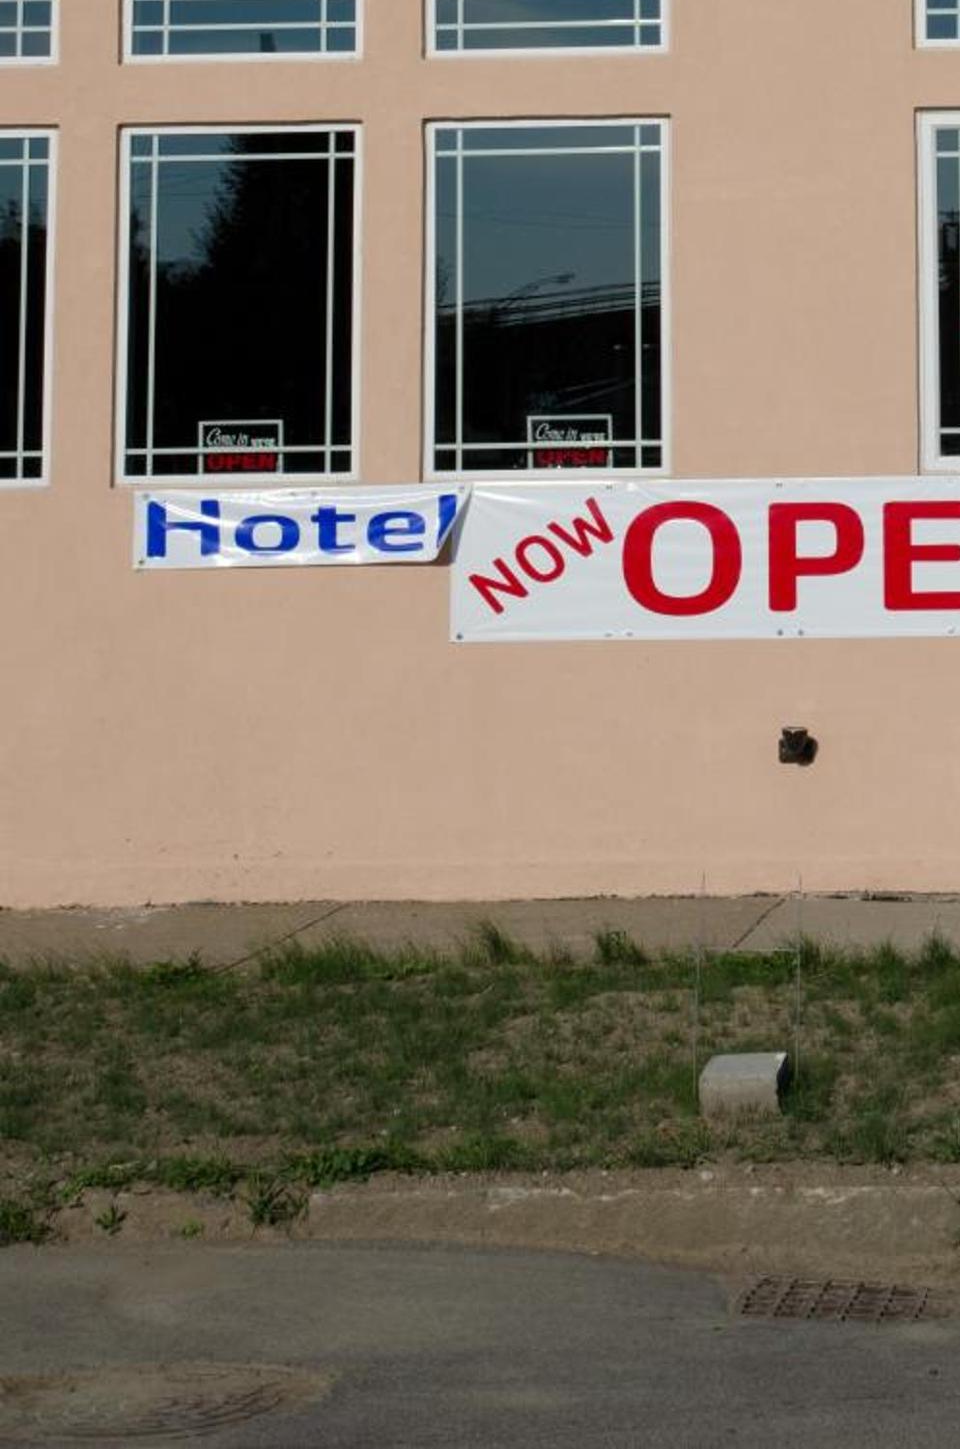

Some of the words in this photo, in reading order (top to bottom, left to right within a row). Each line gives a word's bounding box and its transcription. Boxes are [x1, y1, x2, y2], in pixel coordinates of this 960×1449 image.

[207, 451, 276, 471] OPEN
[537, 447, 607, 466] OPEN
[146, 494, 457, 557] Hotel
[468, 497, 614, 614] NOW
